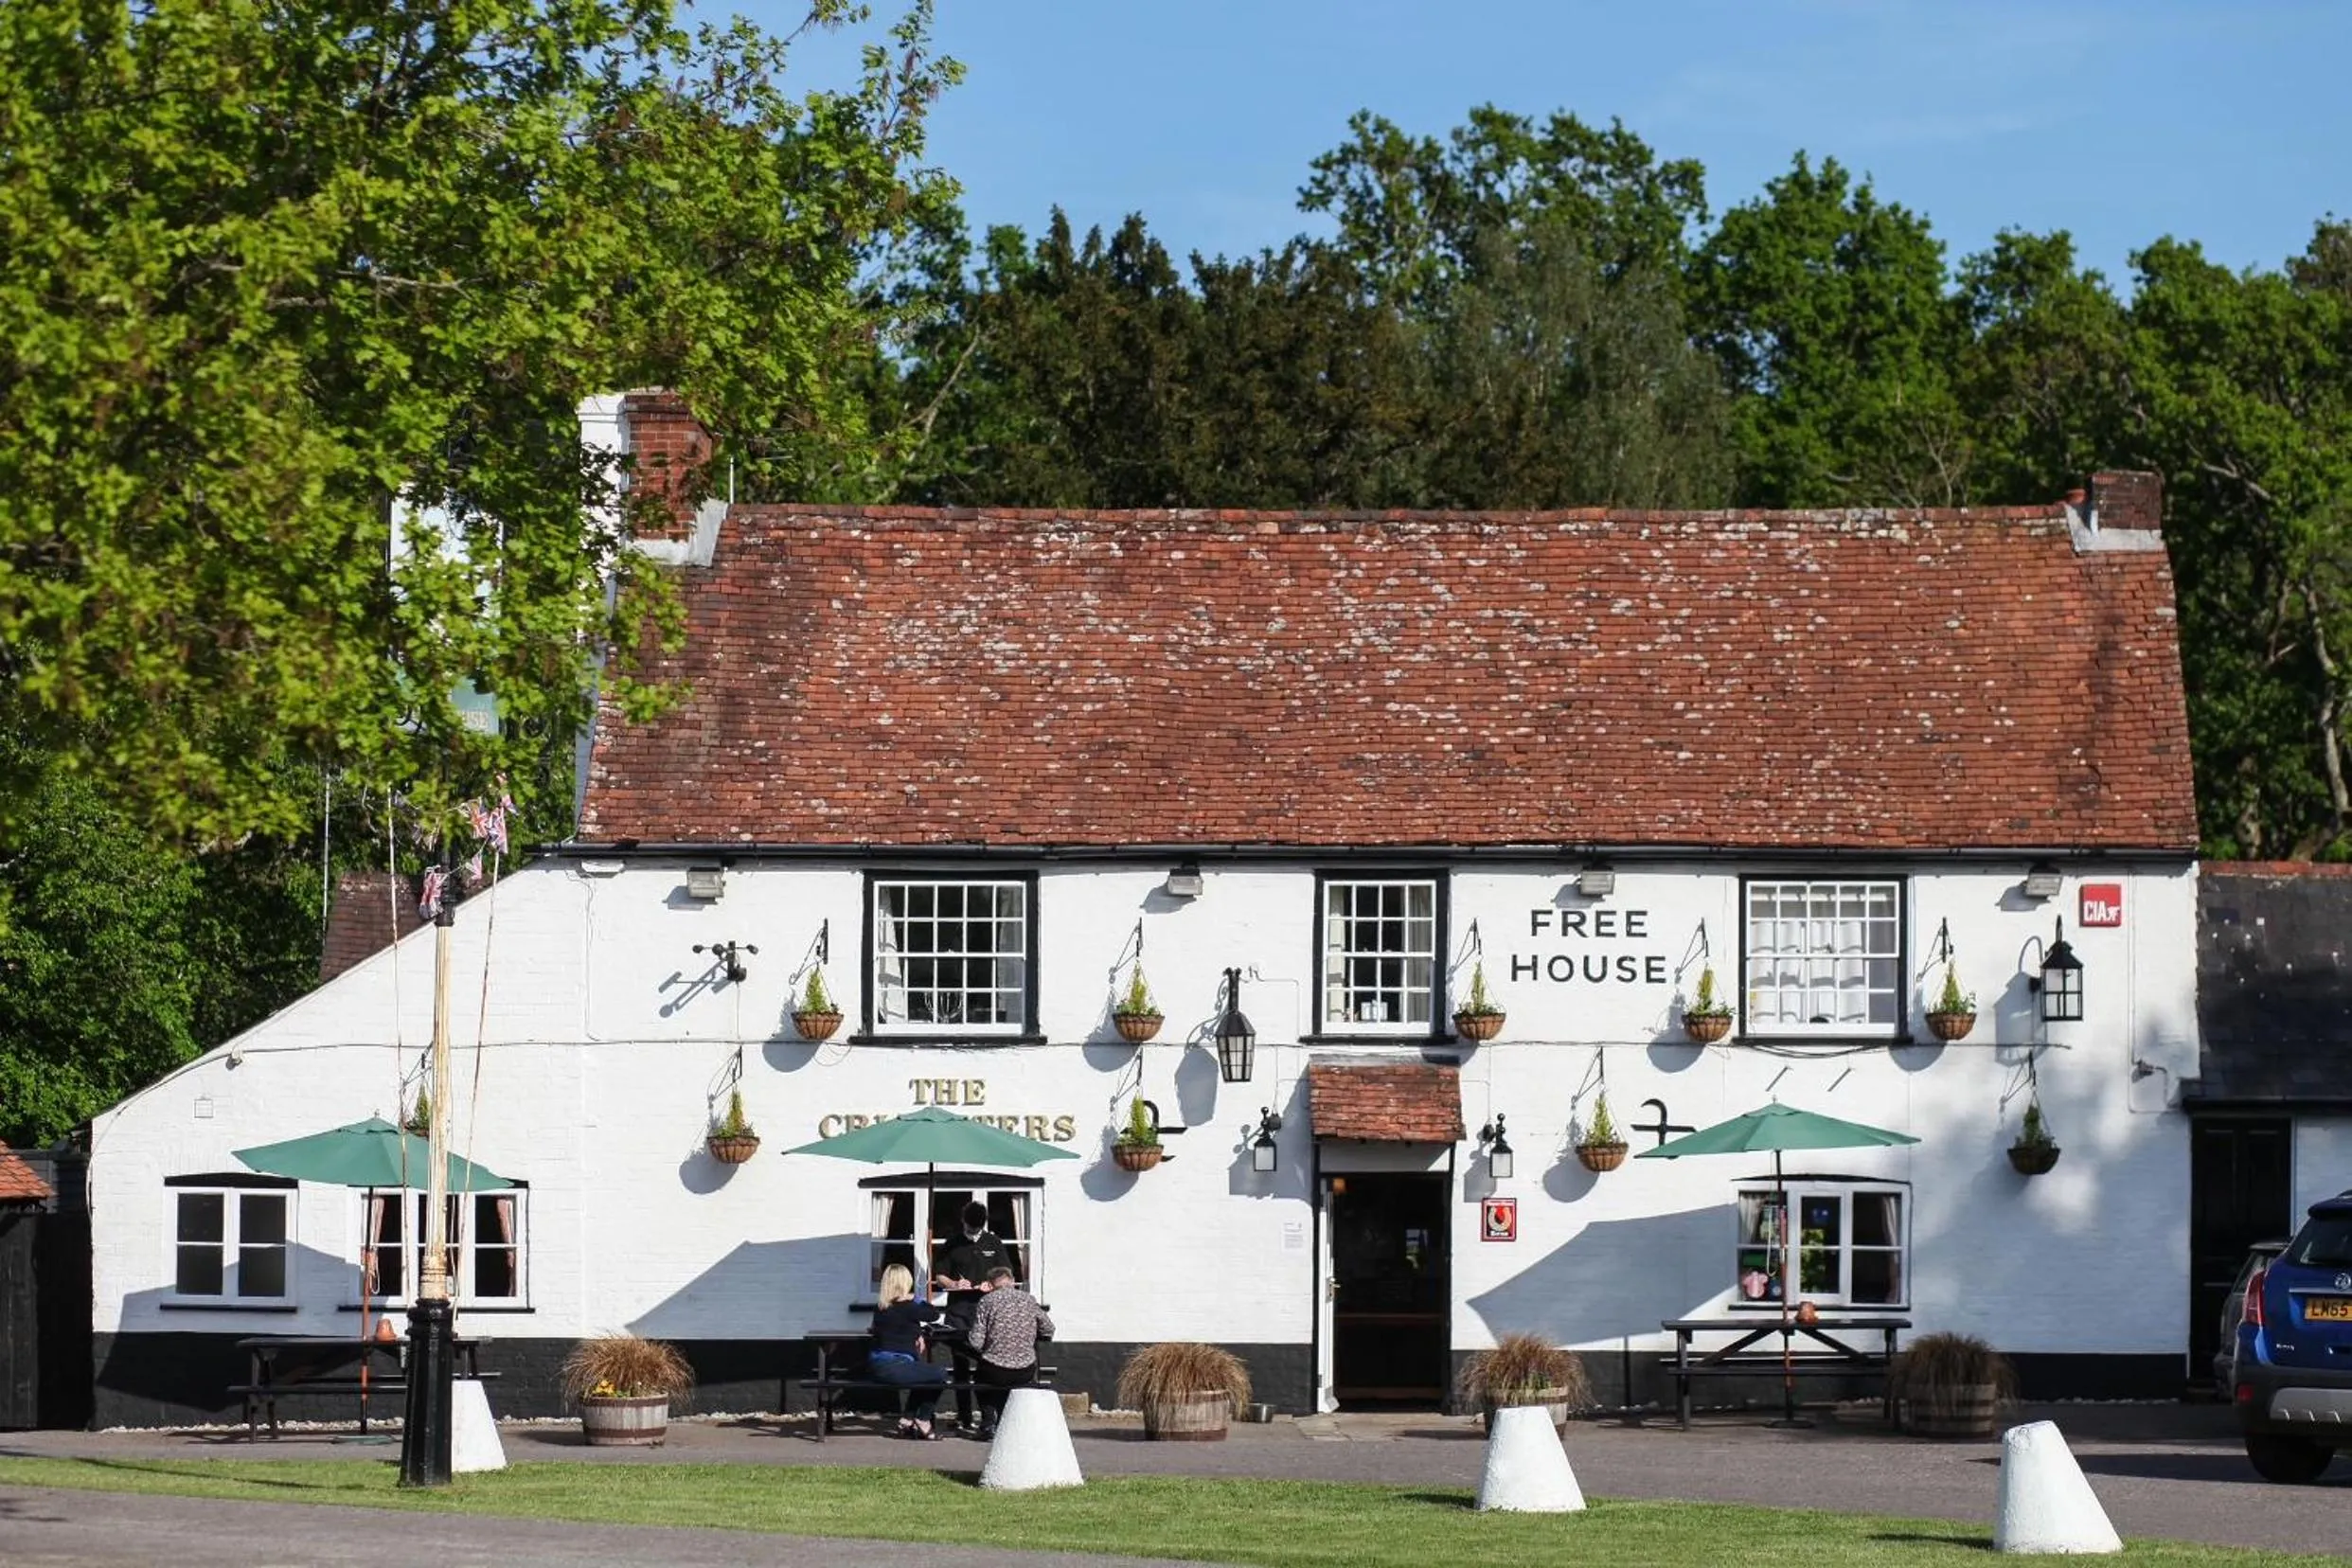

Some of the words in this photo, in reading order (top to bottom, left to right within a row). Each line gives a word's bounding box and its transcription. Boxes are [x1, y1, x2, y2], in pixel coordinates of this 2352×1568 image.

[1531, 909, 1648, 937] FREE
[1511, 953, 1666, 984] HOUSE
[909, 1078, 986, 1106] THE
